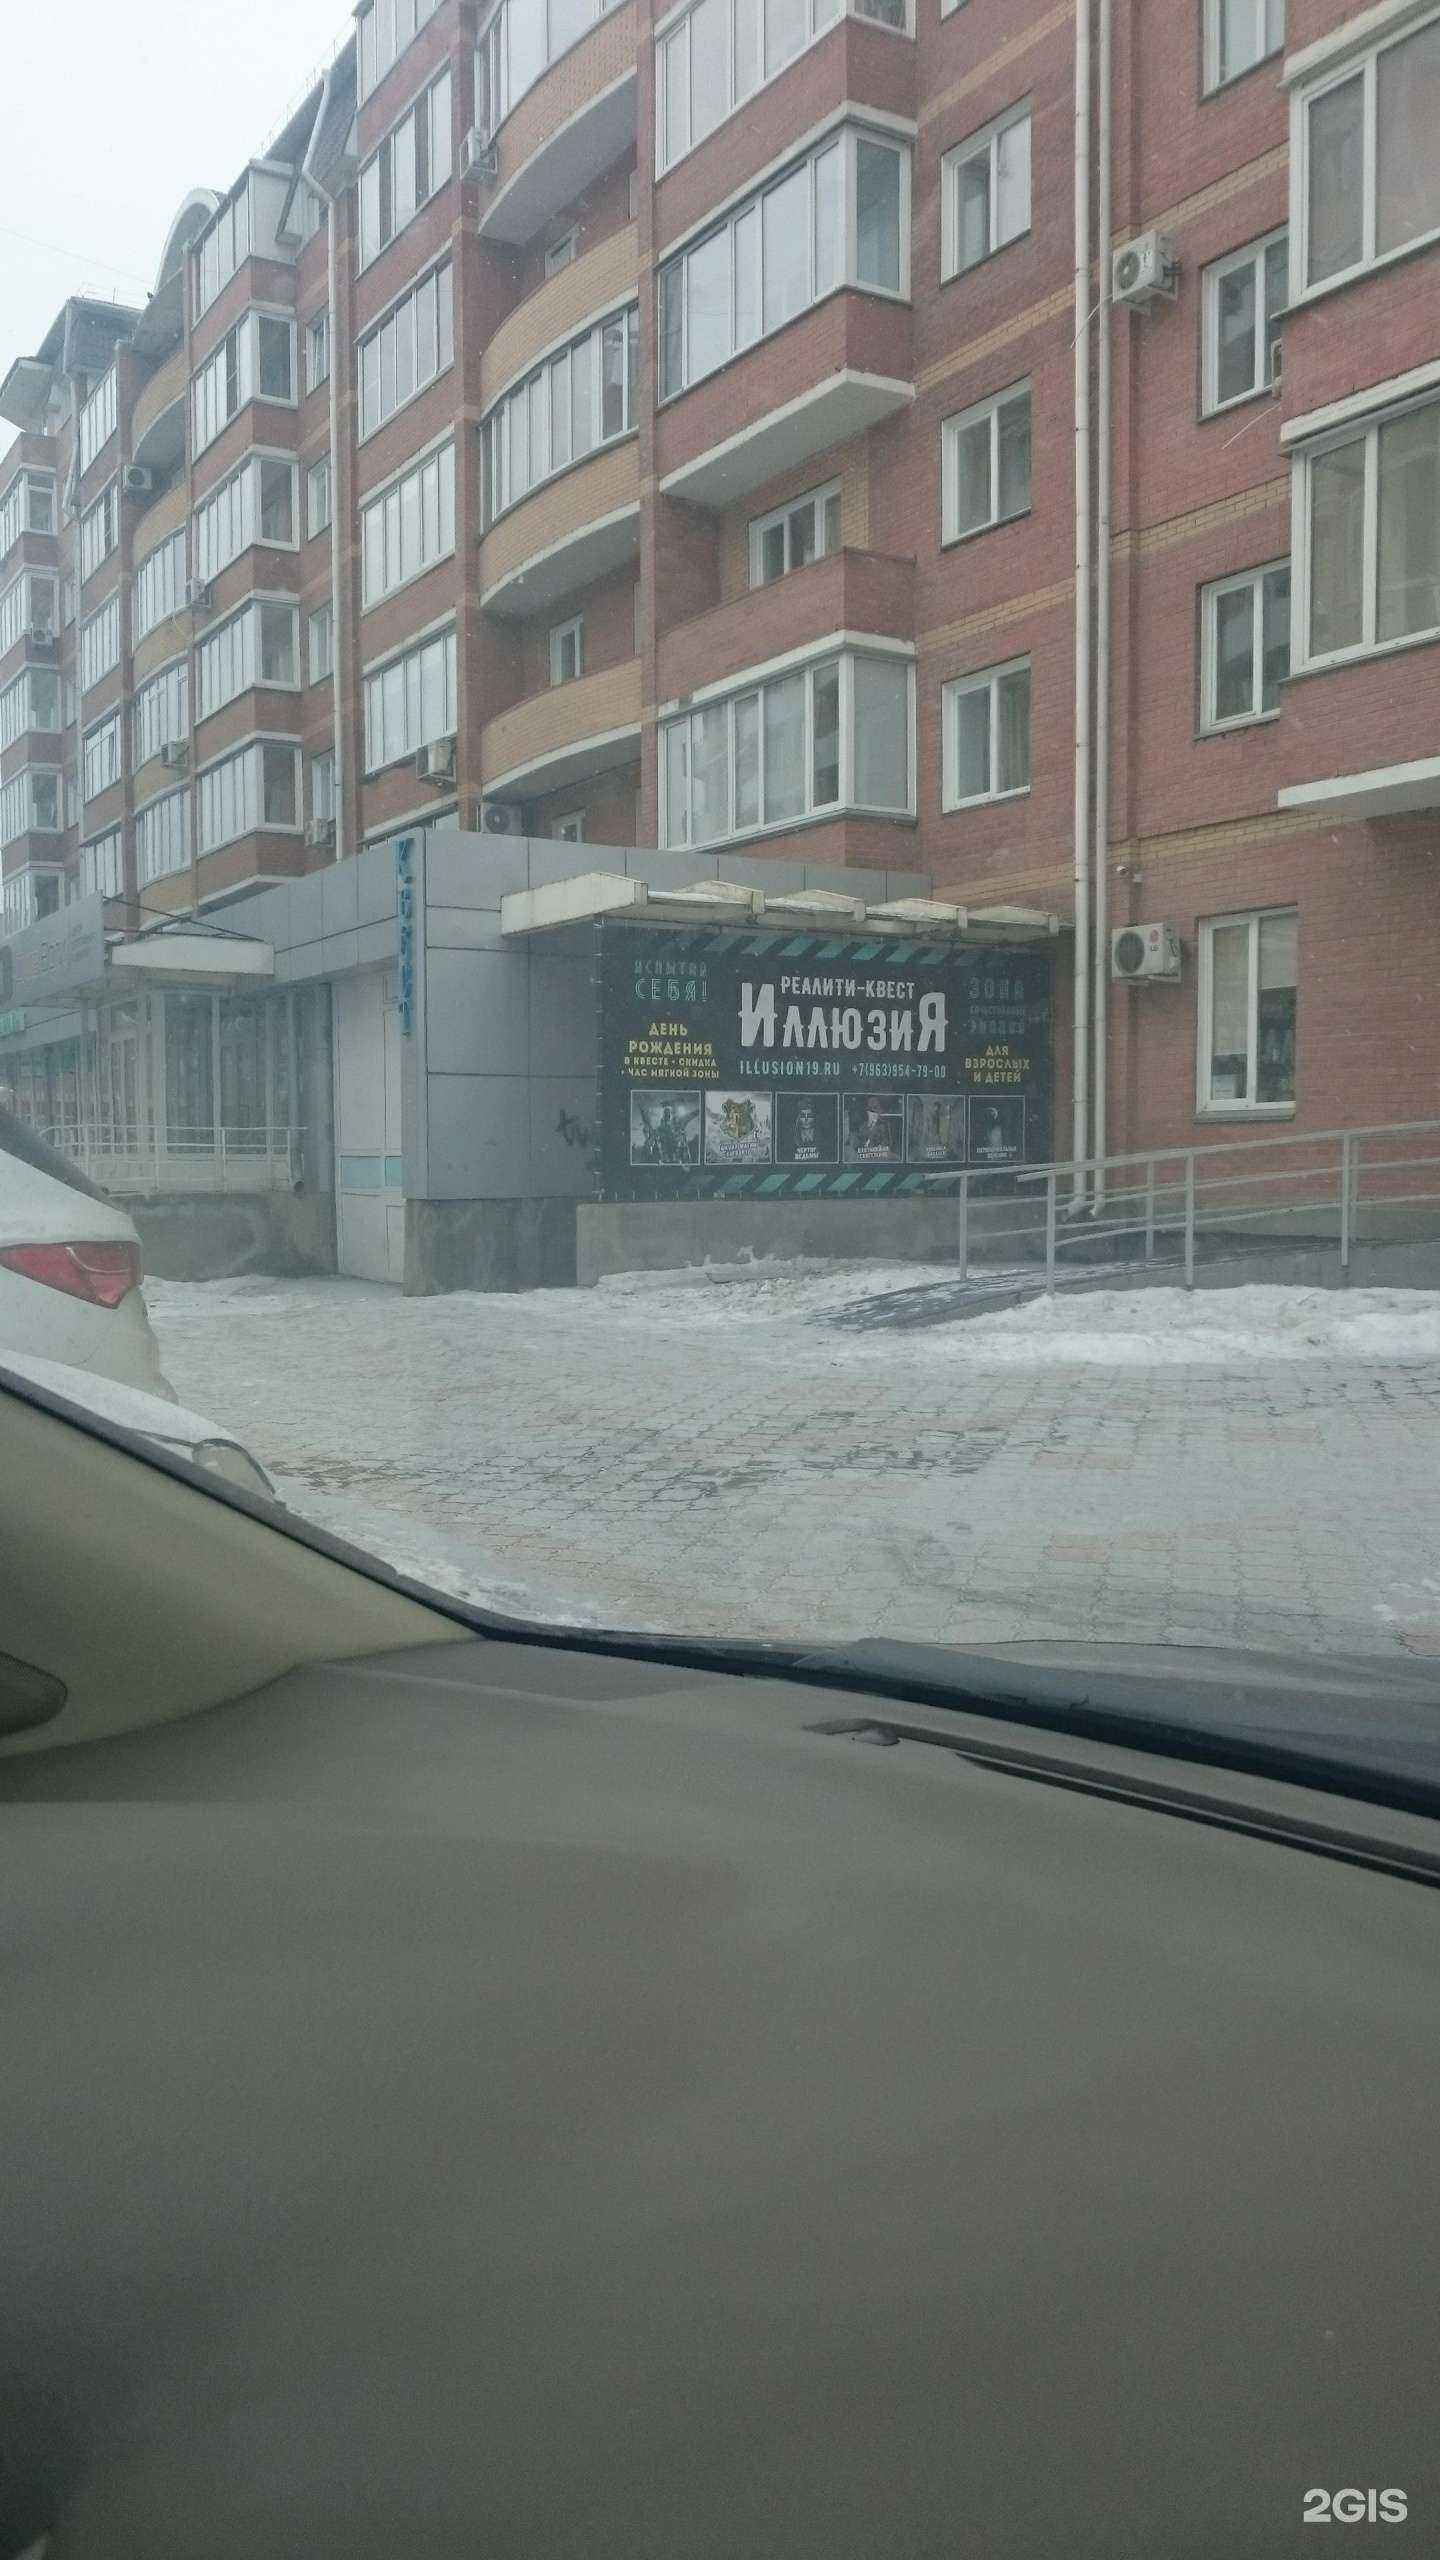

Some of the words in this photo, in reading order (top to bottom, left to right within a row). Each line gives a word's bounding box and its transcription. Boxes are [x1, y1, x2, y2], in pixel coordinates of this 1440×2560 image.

[635, 978, 707, 1002] СЕБЯ!
[781, 975, 916, 999] РЕАЛИТИ-КВЕСТ
[648, 1022, 688, 1036] ДЕНЬ
[629, 1040, 713, 1055] РОЖДЕНИЯ
[984, 1045, 1009, 1056] ДЛЯ
[633, 1057, 669, 1066] КВЕСТЕ
[679, 1058, 717, 1067] СКИДКА
[739, 1059, 840, 1076] ILLUSION19.RU
[964, 1057, 1031, 1070] ВЗРОСЛЫХ
[629, 1068, 648, 1077] ЧАС
[651, 1068, 689, 1078] МЯГКОЙ
[692, 1069, 720, 1079] ЗОНЫ
[973, 1071, 981, 1082] И
[984, 1070, 1022, 1084] ДЕТЕЙ
